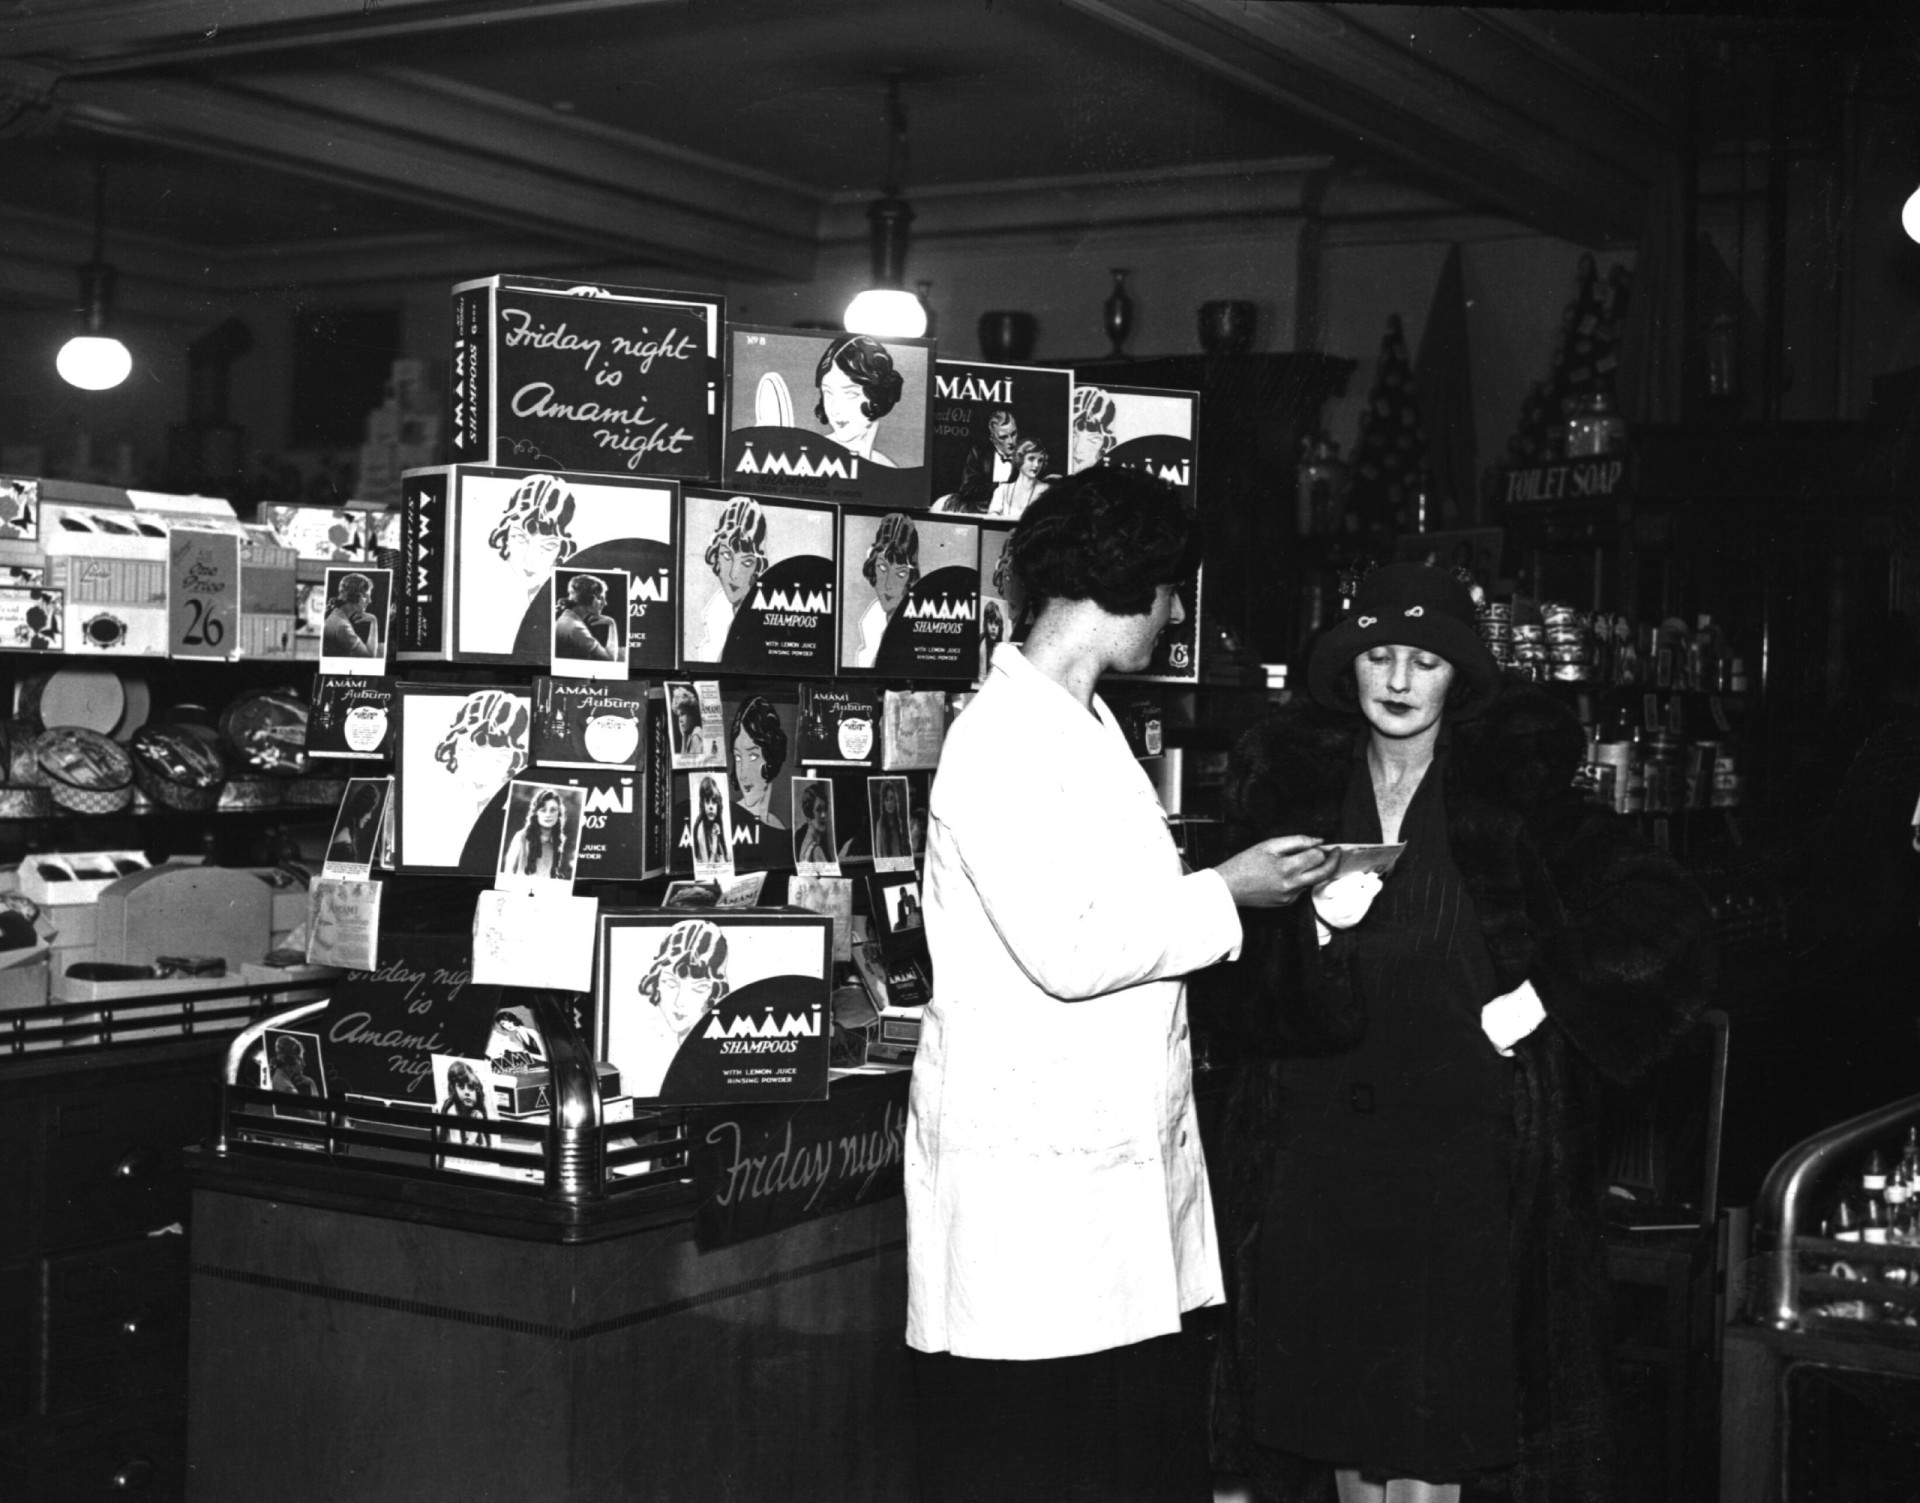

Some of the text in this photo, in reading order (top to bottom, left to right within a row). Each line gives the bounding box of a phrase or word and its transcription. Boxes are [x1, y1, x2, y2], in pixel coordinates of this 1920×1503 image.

[502, 308, 697, 373] Friday night
[595, 361, 622, 386] is
[469, 343, 477, 444] SHAMPOOS
[511, 382, 655, 425] Amami
[934, 425, 970, 437] MPOO
[593, 423, 694, 469] night
[1506, 461, 1623, 502] TOILET SOAP
[405, 496, 414, 597] SHAMPOOS
[189, 562, 218, 576] One
[182, 575, 225, 593] Price
[763, 613, 818, 628] SHAMPOOS
[912, 621, 963, 634] SHAMPOOS
[628, 632, 646, 640] UICE
[341, 689, 391, 701] Auburn
[577, 696, 640, 711] Auburn
[829, 702, 873, 713] Auburn
[432, 957, 472, 1001] nig
[408, 991, 433, 1014] is
[329, 1011, 444, 1050] Amami
[719, 1040, 799, 1054] SHAMPOOS
[388, 1053, 437, 1093] nig
[745, 1068, 772, 1076] LEMON
[705, 1120, 832, 1211] Friday
